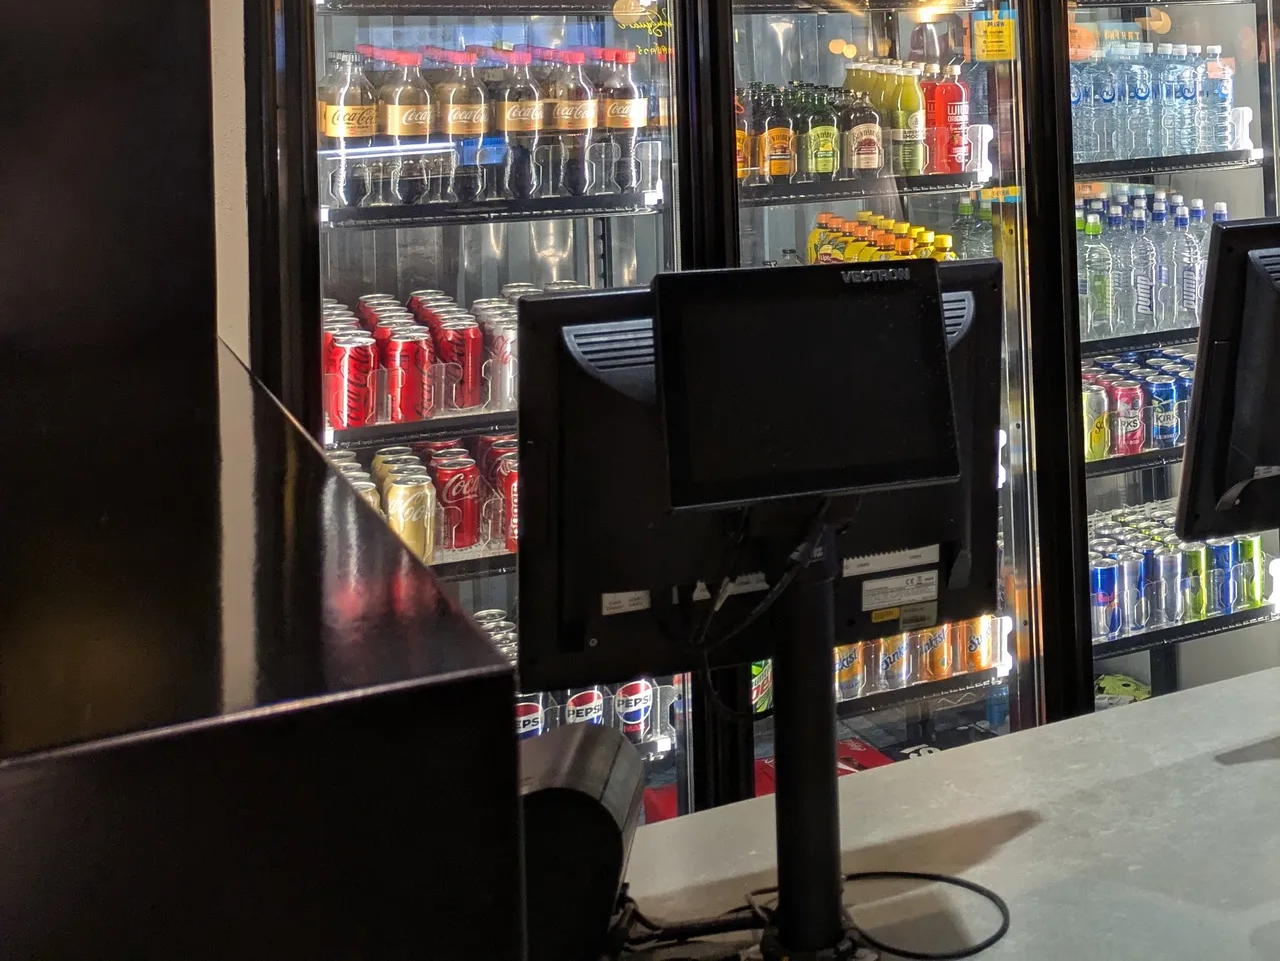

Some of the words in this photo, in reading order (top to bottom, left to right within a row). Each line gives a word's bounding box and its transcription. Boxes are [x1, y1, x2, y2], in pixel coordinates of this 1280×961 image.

[841, 268, 910, 283] VECTRON
[1136, 275, 1154, 315] pump
[617, 695, 650, 708] PEPSI
